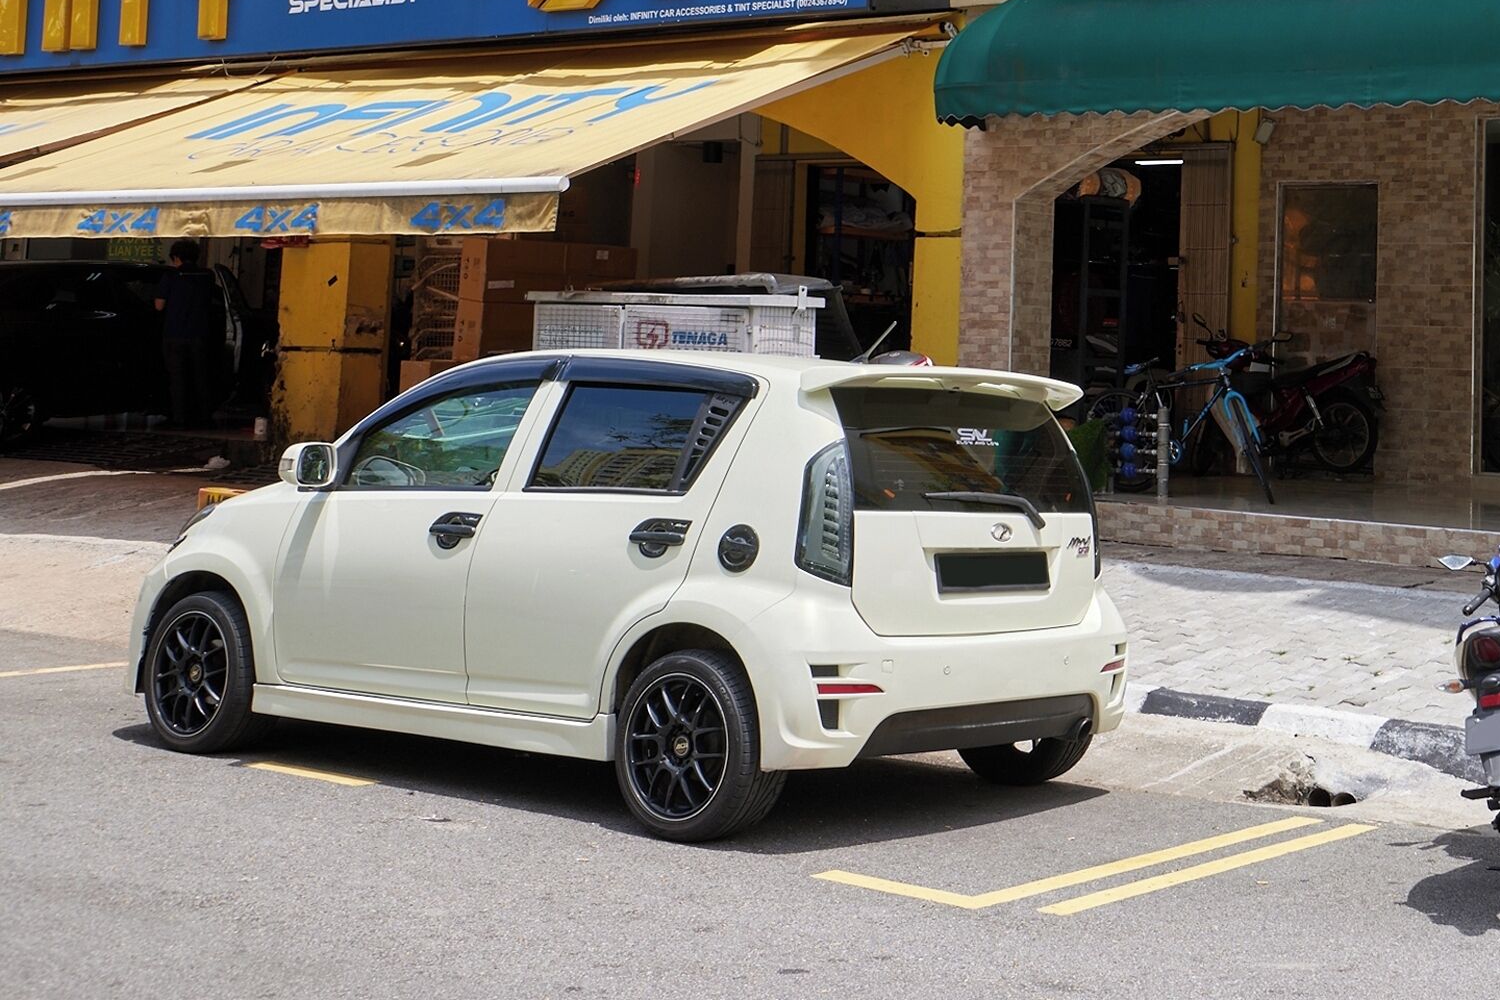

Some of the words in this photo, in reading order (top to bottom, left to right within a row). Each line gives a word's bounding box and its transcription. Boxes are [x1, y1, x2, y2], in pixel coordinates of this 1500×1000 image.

[588, 15, 612, 25] Dimiliki
[612, 13, 629, 23] oleh:
[630, 11, 659, 21] INFINITY
[659, 9, 675, 18] CAR
[675, 5, 726, 17] ACCESSORIES
[727, 4, 733, 13] &
[734, 3, 751, 12] TINT
[752, 0, 795, 11] SPECIALIST
[108, 245, 131, 257] LIAN
[671, 331, 728, 346] TENAGA
